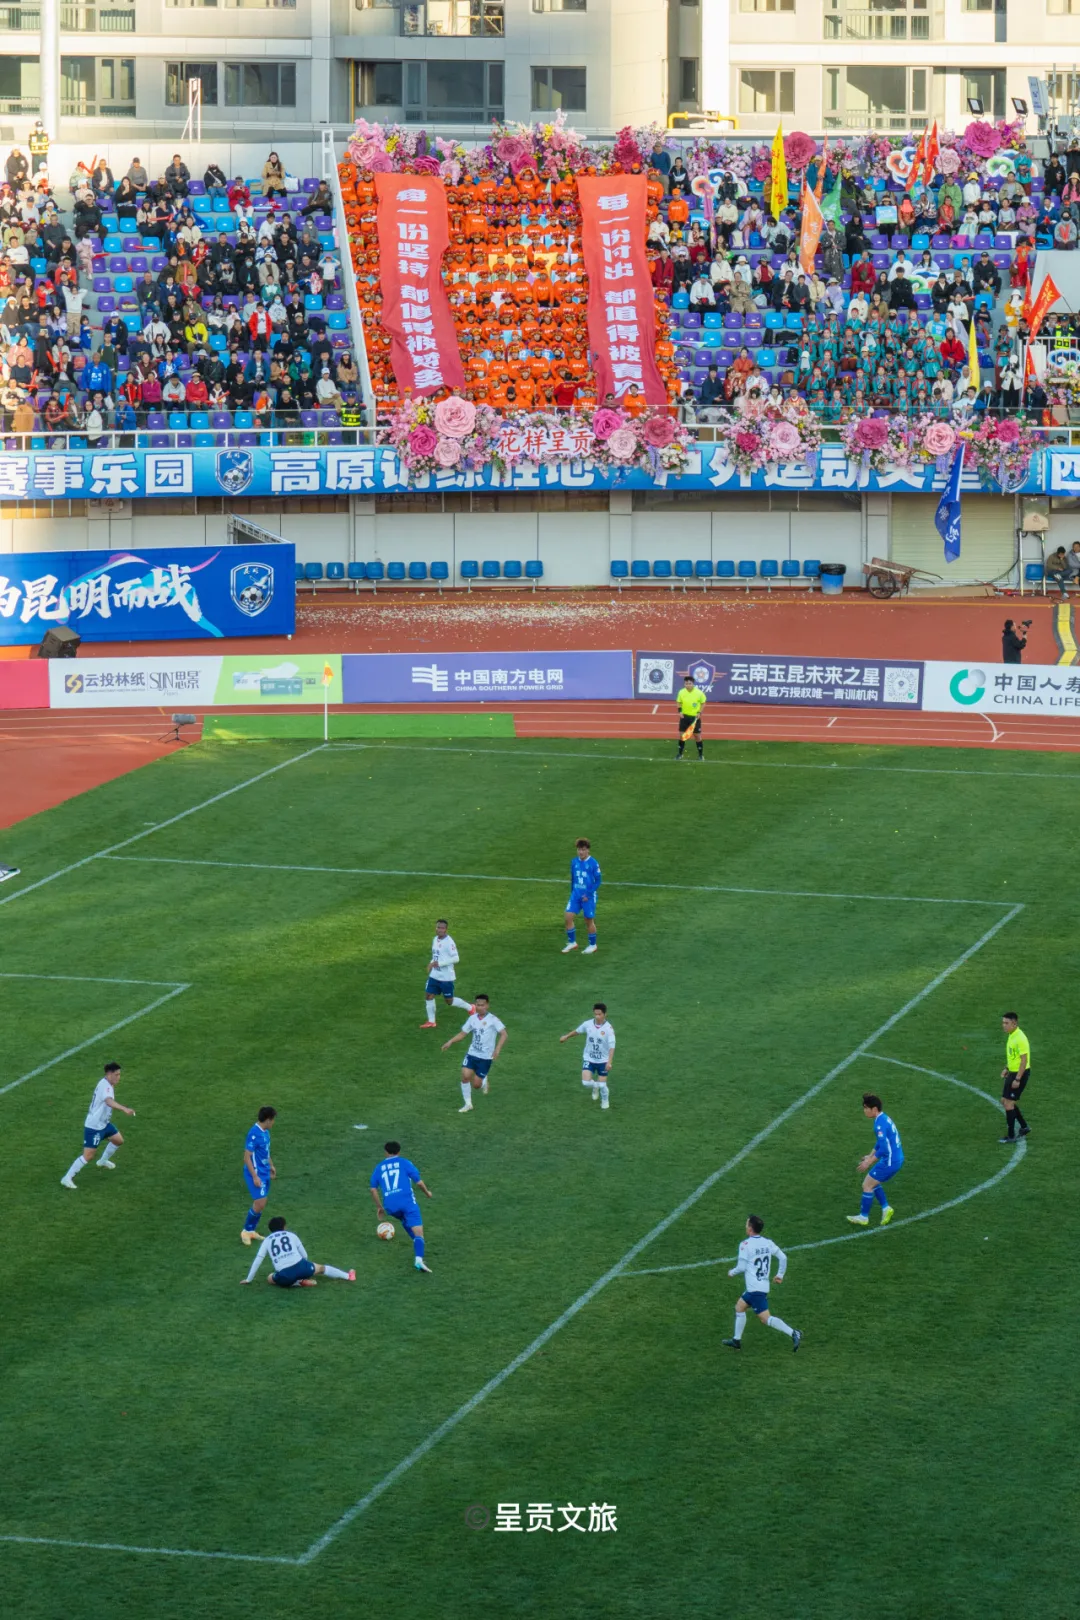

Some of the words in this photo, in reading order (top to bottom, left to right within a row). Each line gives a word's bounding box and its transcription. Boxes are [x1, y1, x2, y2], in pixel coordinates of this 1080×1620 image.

[597, 193, 634, 280] 每一份付出
[499, 430, 594, 455] 花样呈贡
[85, 672, 146, 687] 云投林纸
[454, 668, 564, 685] 中国南方电网
[730, 663, 880, 687] 云南玉昆未来之星
[994, 673, 1080, 694] 中国人寿
[729, 685, 879, 701] U5-U12官方授权唯一青训机构
[993, 694, 1043, 705] CHINA
[1050, 696, 1080, 706] LIFE
[381, 1169, 400, 1191] 17
[270, 1235, 293, 1258] 68
[754, 1255, 770, 1276] 23
